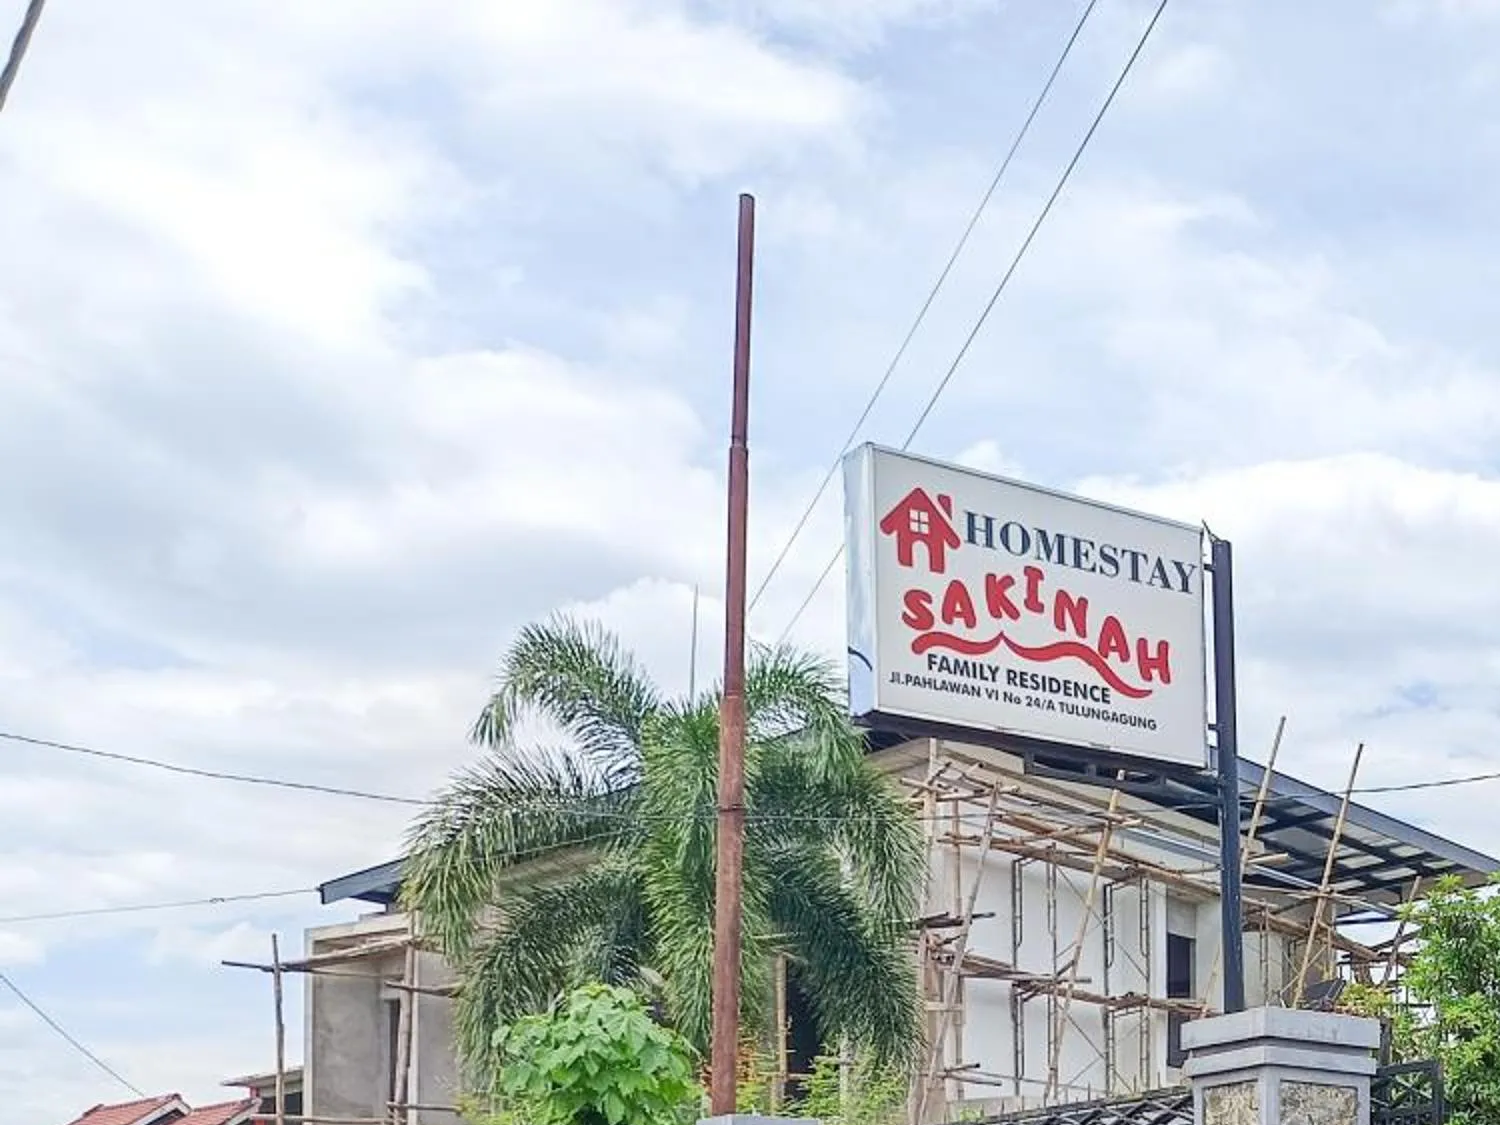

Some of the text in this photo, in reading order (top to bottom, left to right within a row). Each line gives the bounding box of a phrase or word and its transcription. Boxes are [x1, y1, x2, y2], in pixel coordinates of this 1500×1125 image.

[963, 510, 1198, 594] HOMESTAY
[902, 565, 1172, 684] SAKINAH
[927, 653, 1111, 704] FAMILY RESIDENCE
[985, 688, 999, 701] VI
[1003, 691, 1022, 705] No
[1025, 695, 1056, 712] 24/A
[1058, 701, 1158, 731] TULUNGAGUNG
